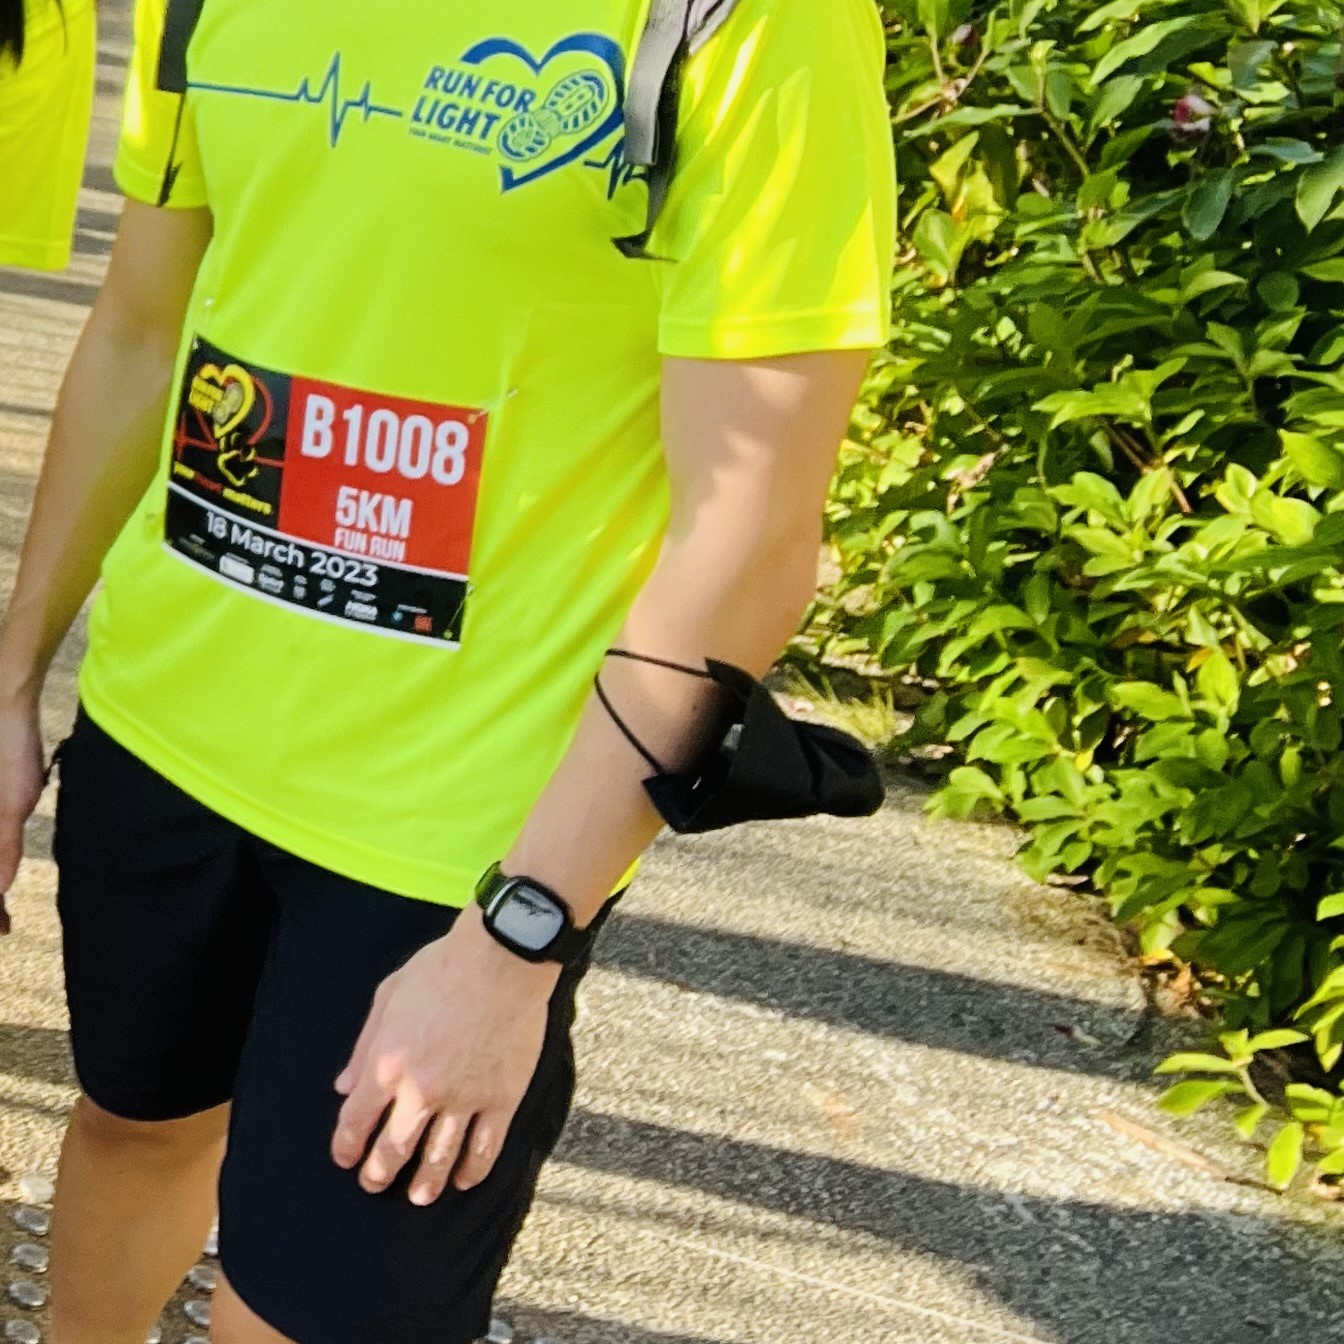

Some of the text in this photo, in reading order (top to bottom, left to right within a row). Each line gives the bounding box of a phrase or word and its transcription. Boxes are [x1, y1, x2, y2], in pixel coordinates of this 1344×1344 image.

[424, 65, 536, 114] RUN FOR
[411, 94, 501, 141] LIGHT
[301, 393, 469, 486] B1008
[335, 485, 413, 539] 5KM
[206, 510, 228, 539] 18
[230, 523, 305, 567] March
[308, 551, 380, 587] 2023
[334, 527, 406, 564] FUN RUN
